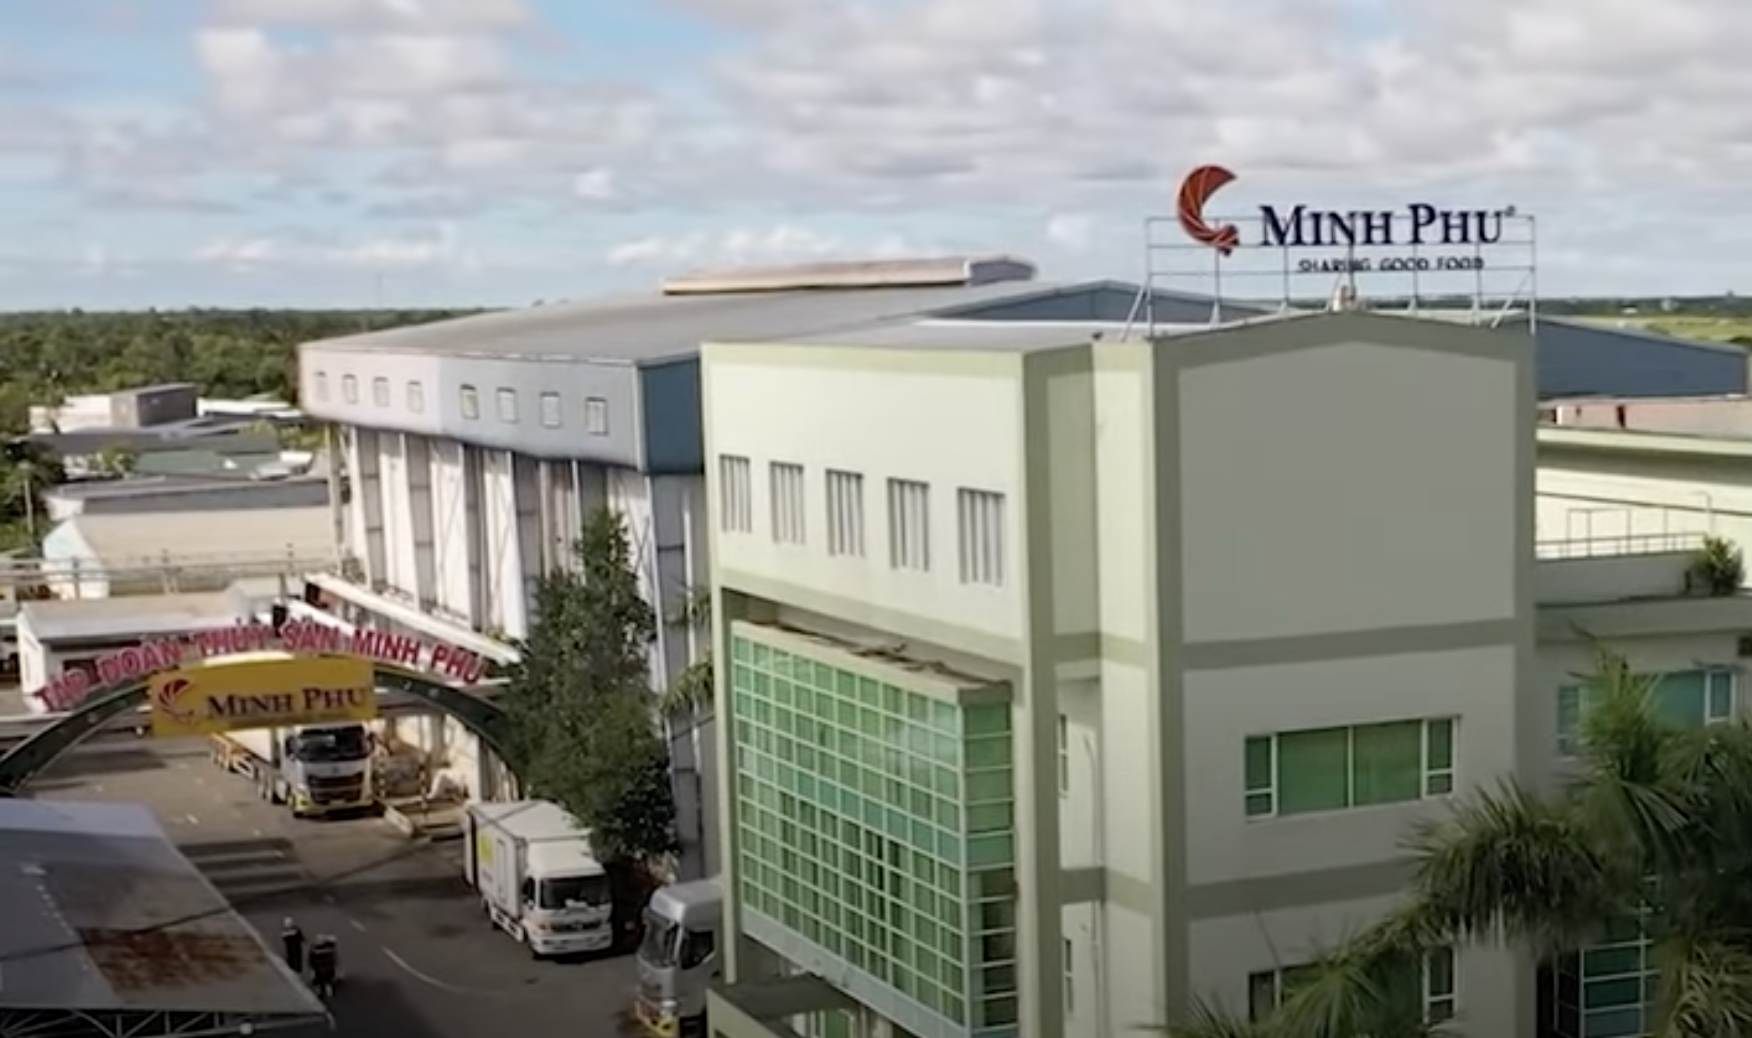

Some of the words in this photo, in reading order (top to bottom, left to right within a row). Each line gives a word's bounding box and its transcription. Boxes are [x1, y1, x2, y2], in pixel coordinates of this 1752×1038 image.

[1258, 204, 1394, 247] MINH
[1380, 257, 1429, 272] GOOD
[1437, 256, 1485, 271] FOOD
[351, 627, 420, 664] MINH
[205, 692, 293, 718] MINH
[302, 685, 367, 712] PHU
